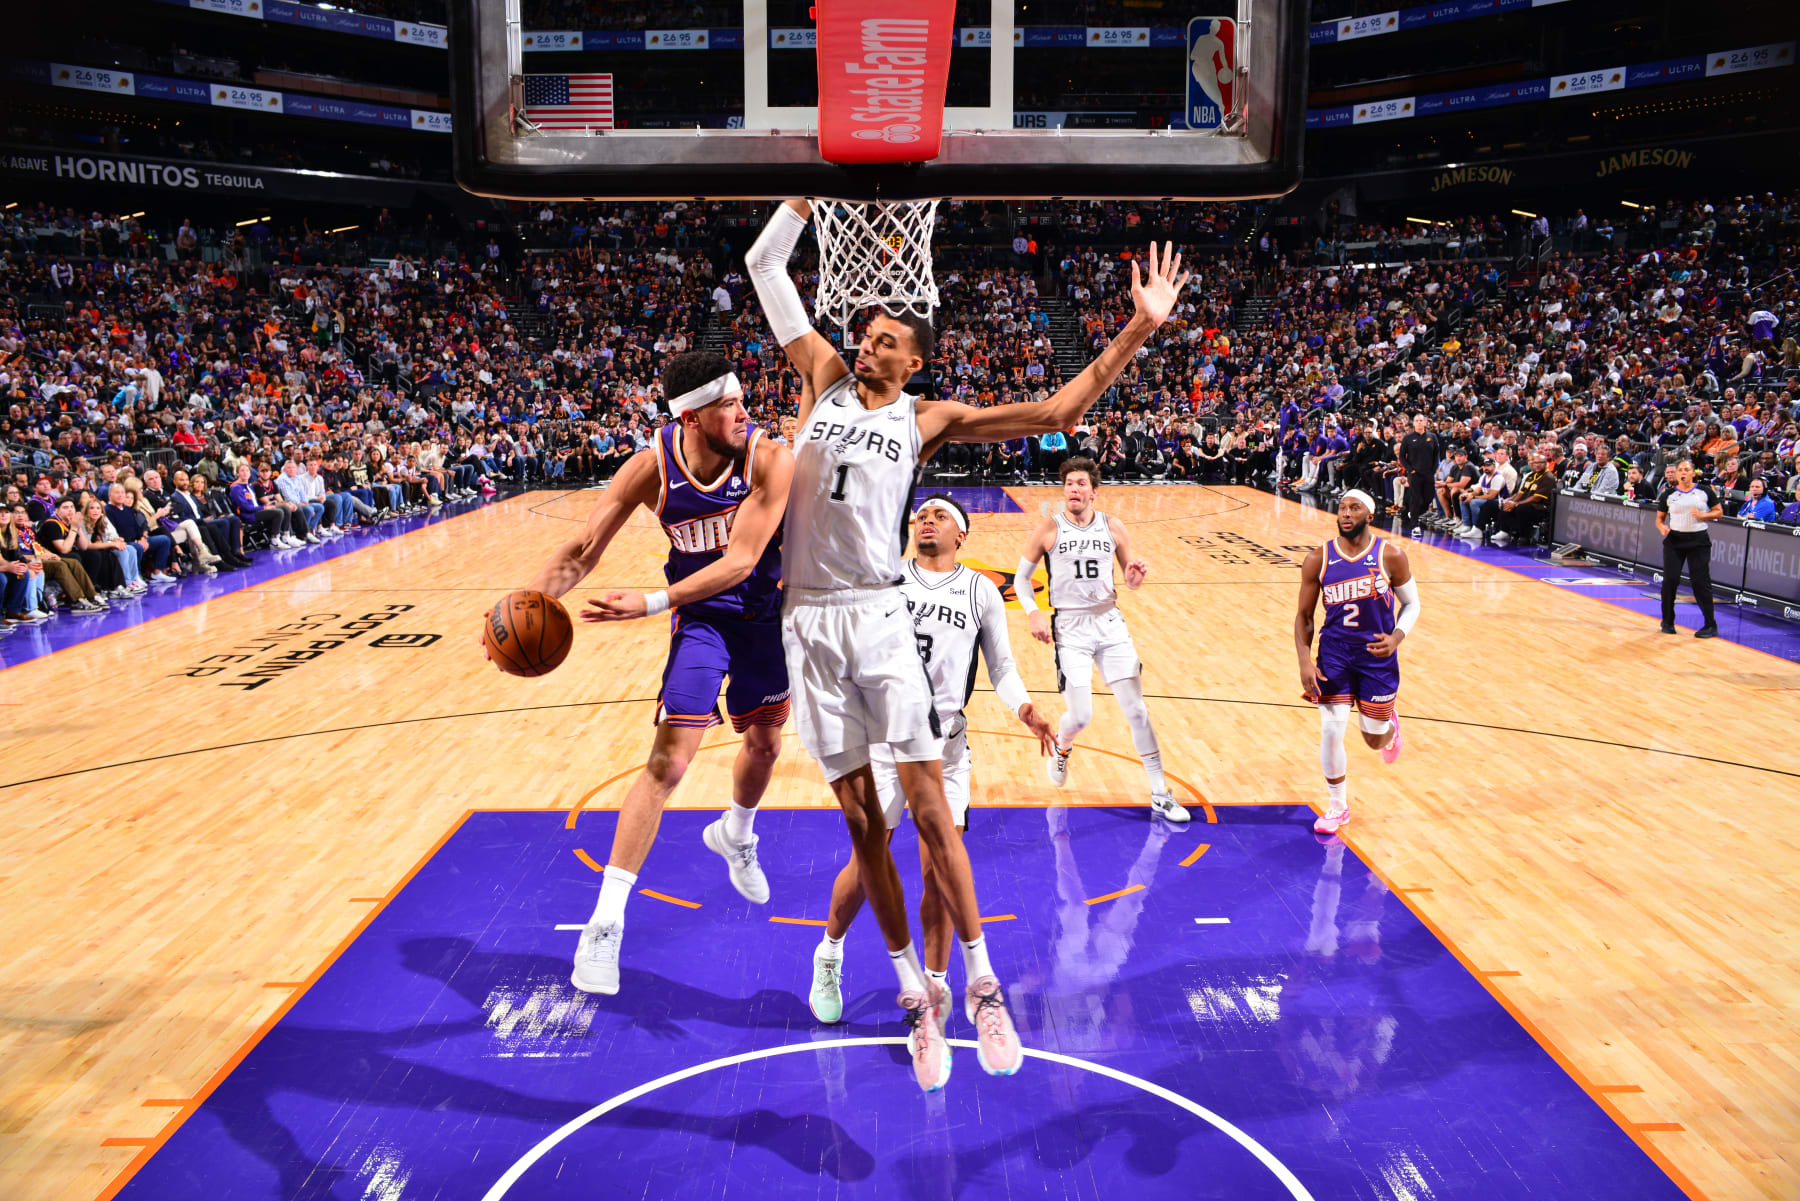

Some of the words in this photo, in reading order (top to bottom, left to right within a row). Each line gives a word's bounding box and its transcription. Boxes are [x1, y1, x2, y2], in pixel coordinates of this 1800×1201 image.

[300, 13, 328, 23] ULTRA
[1433, 6, 1460, 18] ULTRA
[366, 22, 392, 33] ULTRA
[1354, 21, 1367, 30] 2.6
[1370, 18, 1382, 27] 95
[411, 27, 426, 38] 2.6
[427, 30, 439, 40] 95
[536, 34, 551, 43] 2.6
[553, 34, 566, 43] 95
[663, 33, 677, 41] 2.6
[679, 33, 691, 41] 95
[1056, 32, 1083, 41] ULTRA
[1104, 30, 1118, 39] 2.6
[1120, 30, 1132, 39] 95
[845, 19, 929, 122] StateFarm
[1668, 63, 1701, 74] ULTRA
[75, 70, 92, 81] 2.6
[96, 73, 111, 83] 95
[1571, 76, 1586, 86] 2.6
[1590, 74, 1604, 84] 95
[177, 87, 206, 97] ULTRA
[231, 90, 246, 100] 2.6
[250, 93, 262, 102] 95
[1517, 86, 1546, 96] ULTRA
[1449, 96, 1476, 105] ULTRA
[319, 103, 345, 114] ULTRA
[1192, 106, 1216, 120] NBA
[1370, 104, 1383, 113] 2.6
[1386, 103, 1398, 111] 95
[383, 112, 407, 121] ULTRA
[1012, 114, 1048, 128] URS
[1325, 112, 1350, 121] ULTRA
[1596, 148, 1690, 177] JAMESON
[10, 157, 48, 171] AGAVE
[55, 155, 199, 188] HORNITOS
[204, 173, 264, 190] TEQUILA
[1430, 166, 1511, 192] JAMESON
[810, 421, 902, 462] SPURS
[829, 463, 850, 502] 1
[1567, 516, 1643, 554] SPORTS
[1059, 539, 1111, 554] SPURS
[1711, 538, 1726, 563] OR
[1728, 544, 1787, 577] CHANNEL
[1074, 559, 1099, 579] 16
[1323, 576, 1373, 604] SUNS
[907, 600, 967, 630] PURS
[1343, 603, 1360, 627] 2
[166, 613, 342, 678] CENTER
[219, 604, 416, 690] FOOTPRINT
